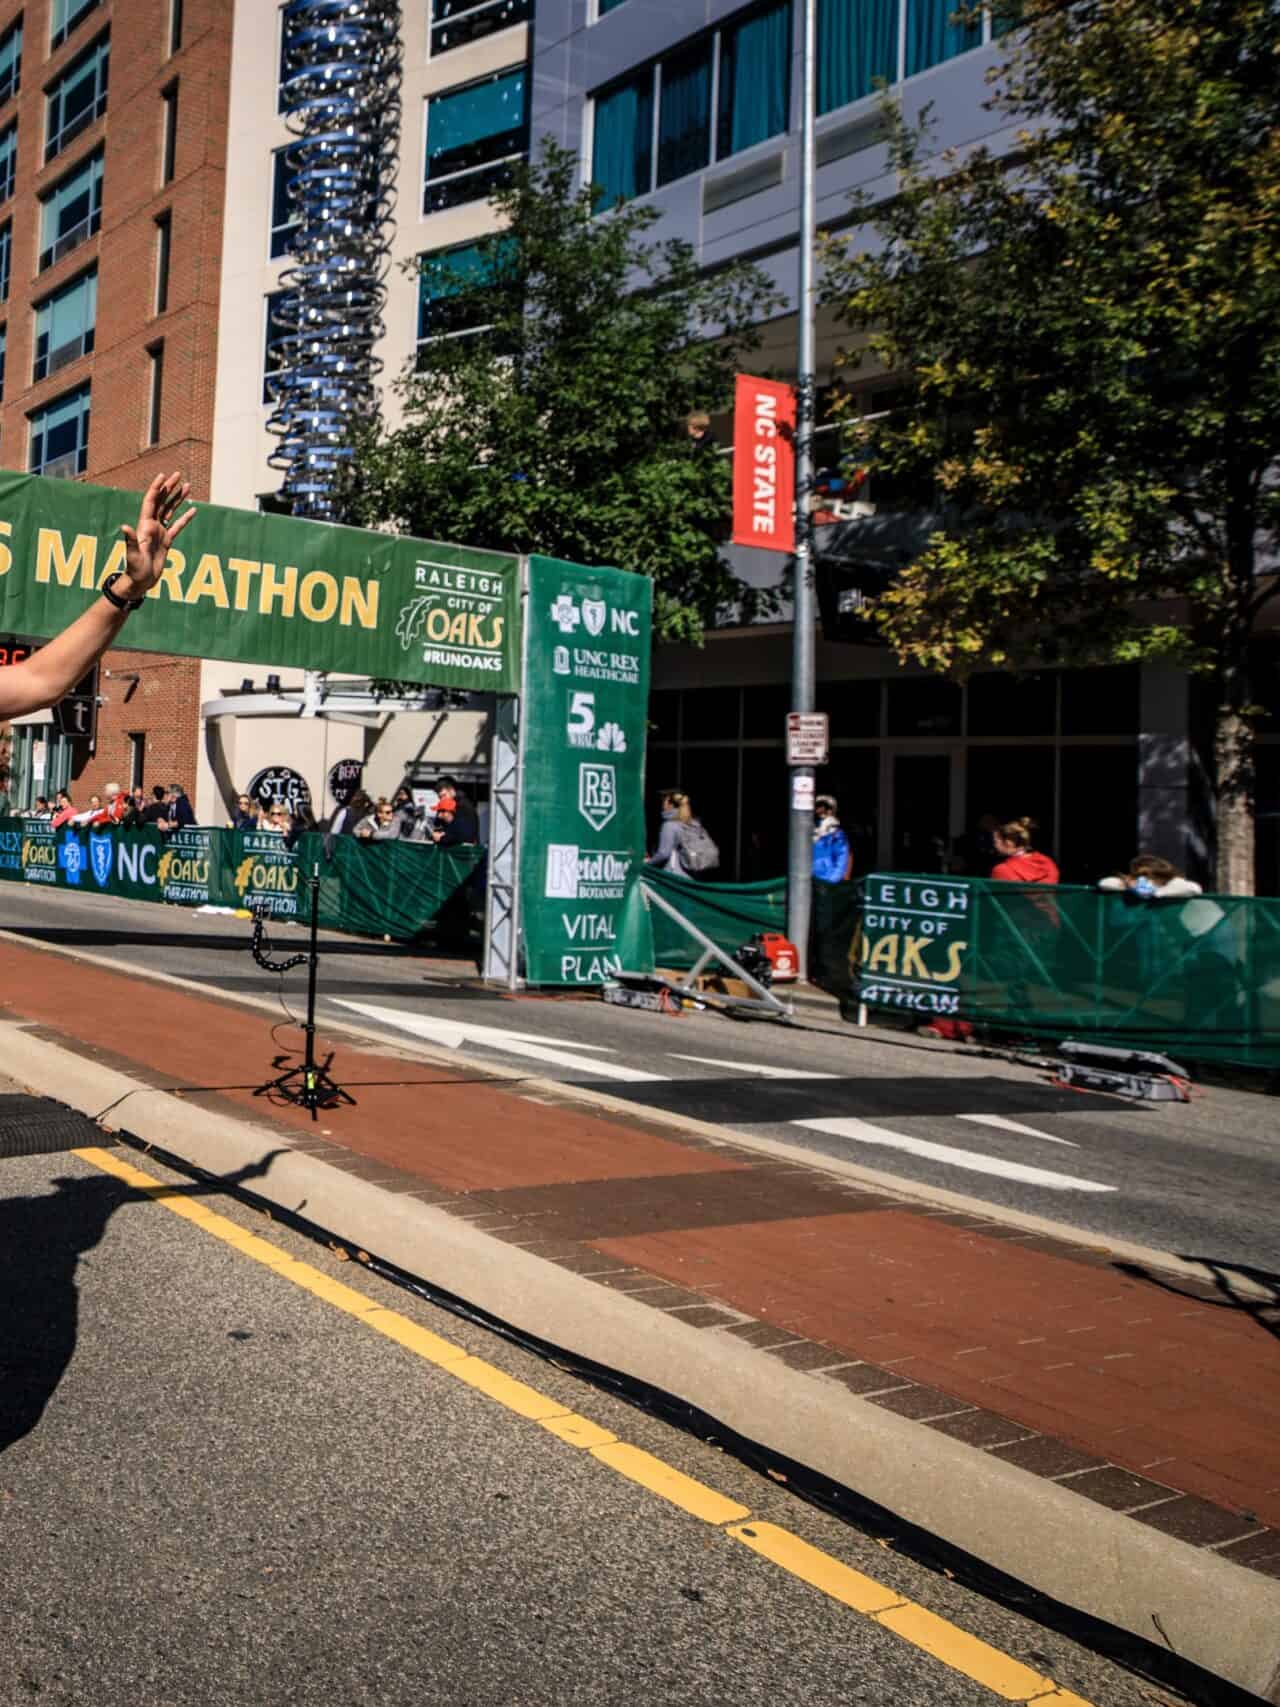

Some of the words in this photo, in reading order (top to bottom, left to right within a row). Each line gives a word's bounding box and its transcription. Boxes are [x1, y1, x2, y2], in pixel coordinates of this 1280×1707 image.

[755, 393, 777, 438] NC
[753, 444, 777, 535] STATE
[415, 567, 503, 595] RALEIGH
[447, 597, 475, 611] CITY
[478, 603, 493, 614] OF
[427, 609, 504, 649] OAKS
[611, 608, 640, 637] NC
[423, 650, 503, 672] #RUNOAKS
[574, 648, 608, 667] UNC
[609, 654, 640, 671] REX
[575, 665, 640, 684] HEALTHCARE
[567, 692, 595, 733] 5
[584, 771, 613, 807] R&D
[170, 833, 209, 845] ALEIGH
[243, 836, 299, 851] RALE
[117, 842, 156, 885] NC
[171, 858, 209, 883] OAKS
[252, 864, 299, 892] OAKS
[865, 884, 968, 911] EIGH
[562, 914, 617, 941] VITAL
[865, 914, 912, 932] CITY
[920, 920, 949, 935] OF
[562, 955, 623, 982] PLAN
[863, 933, 968, 983] AKS
